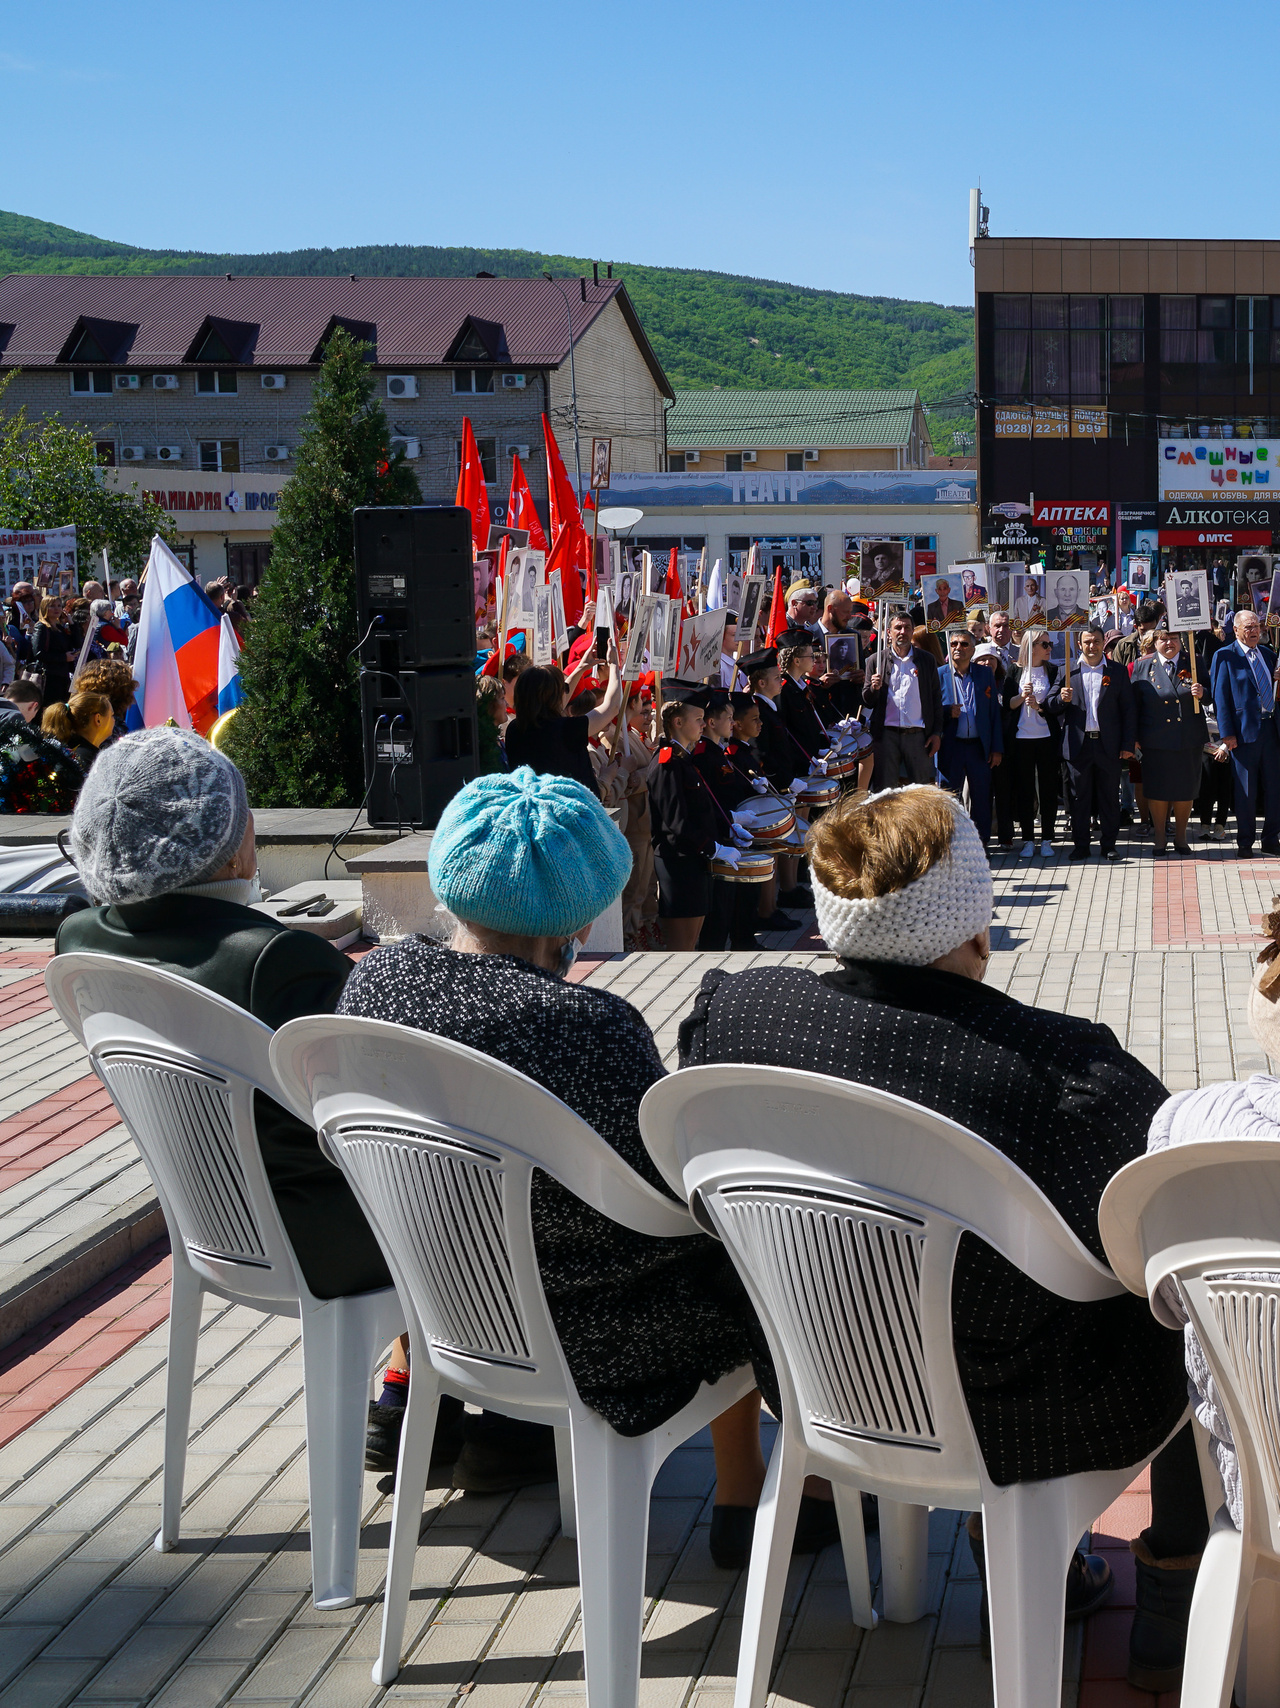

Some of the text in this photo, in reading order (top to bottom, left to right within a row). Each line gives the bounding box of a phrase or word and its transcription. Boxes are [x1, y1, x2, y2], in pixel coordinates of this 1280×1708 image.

[995, 424, 1102, 434] 8(928) 22-11 999
[728, 474, 805, 503] ТЕАТР
[1168, 492, 1204, 500] ОДЕЖДА
[1253, 492, 1271, 500] ДЛЯ
[1037, 507, 1108, 521] АПТЕКА
[1165, 506, 1271, 525] Алкотека
[991, 536, 1040, 545] МИМИНО
[1206, 534, 1233, 543] МТС
